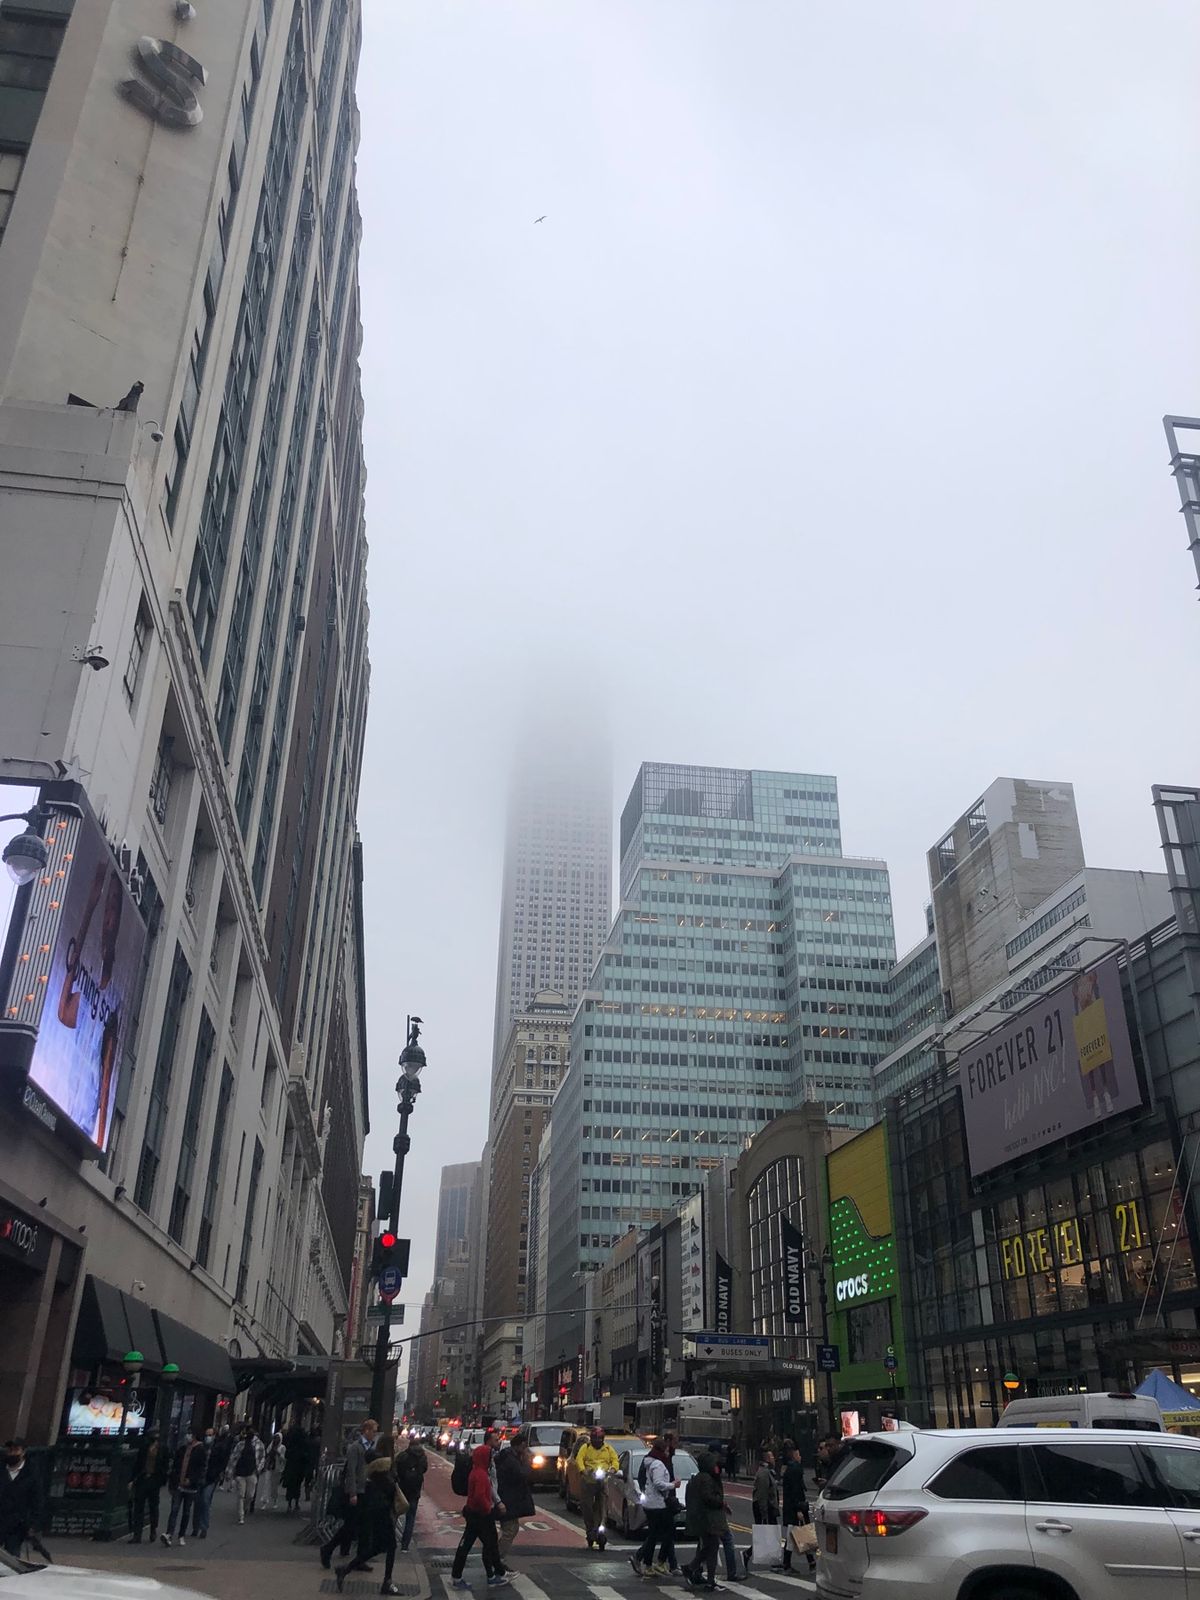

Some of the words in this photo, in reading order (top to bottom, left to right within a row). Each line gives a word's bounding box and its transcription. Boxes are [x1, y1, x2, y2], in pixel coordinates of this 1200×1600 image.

[967, 1025, 1038, 1099] FOREVER
[1044, 1009, 1064, 1055] 21
[1080, 1036, 1101, 1057] FOREVER
[1115, 1200, 1142, 1252] 21
[786, 1246, 800, 1284] NAVY
[718, 1277, 729, 1310] NAVY
[789, 1286, 801, 1315] OLD
[836, 1273, 869, 1302] crocs
[718, 1310, 728, 1334] OLD
[720, 1348, 744, 1356] BUSES
[744, 1349, 762, 1357] ONLY
[772, 1389, 780, 1402] OLD
[780, 1387, 791, 1401] NAVY
[1172, 1415, 1190, 1423] SAFE
